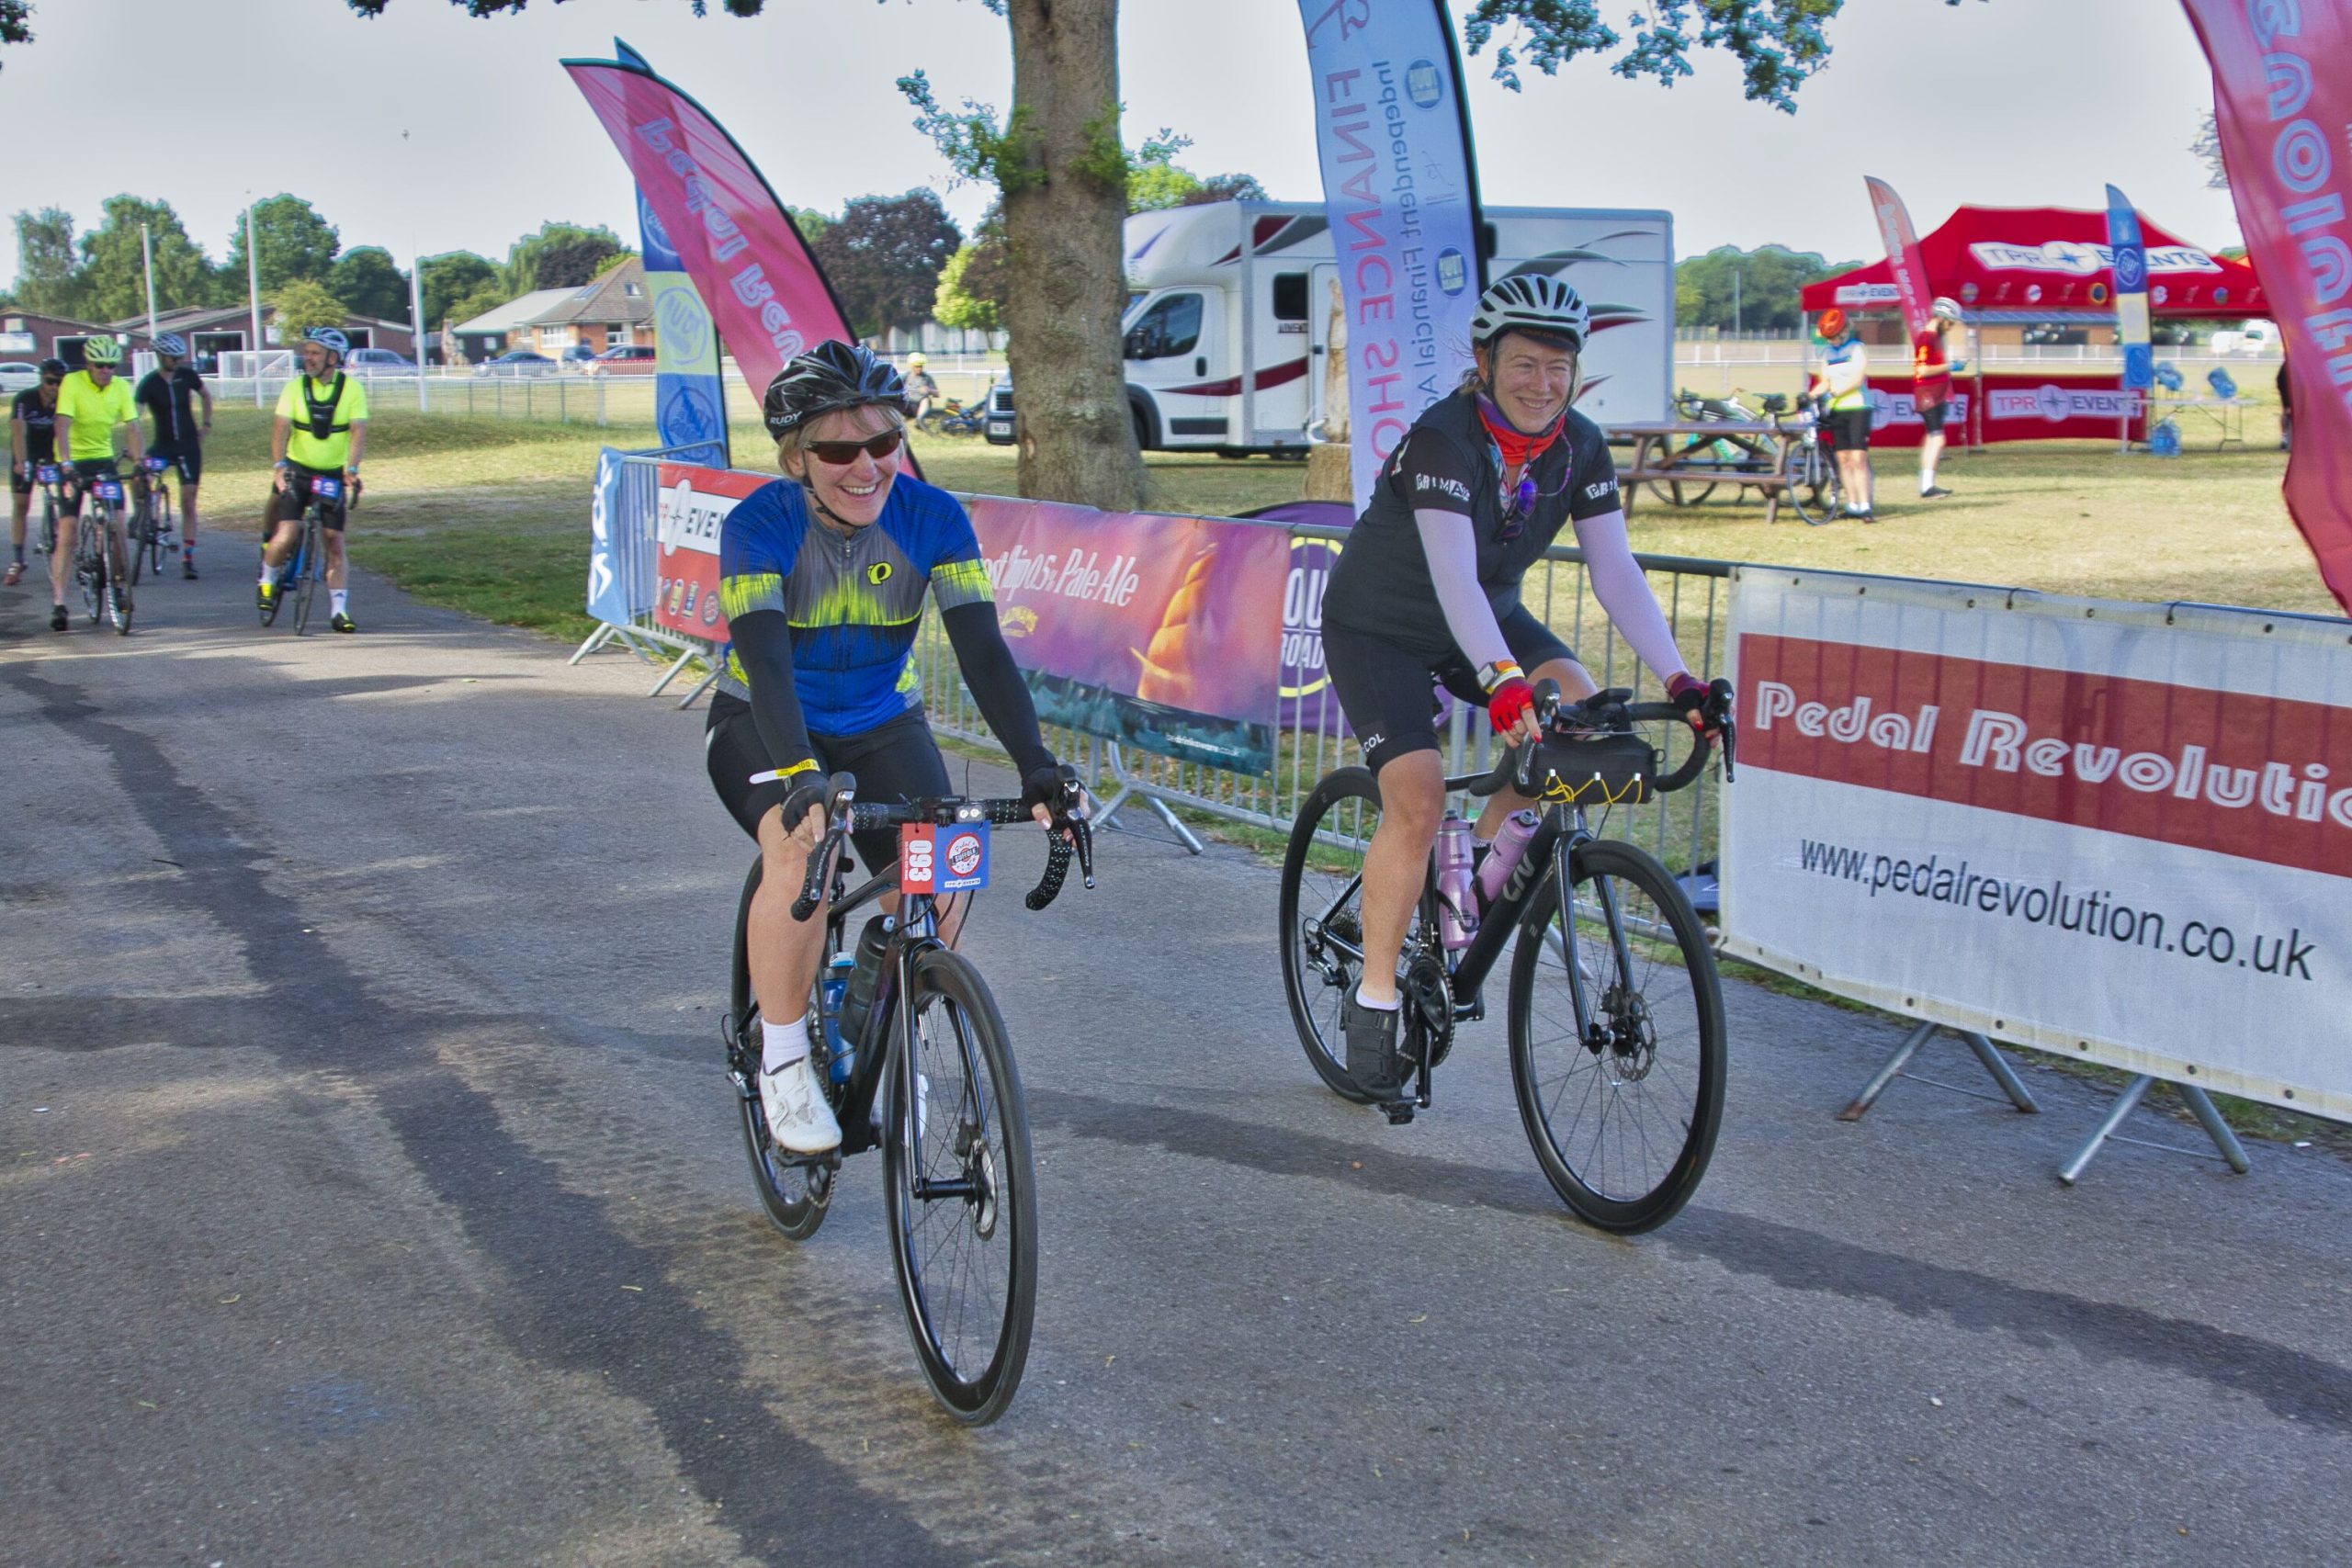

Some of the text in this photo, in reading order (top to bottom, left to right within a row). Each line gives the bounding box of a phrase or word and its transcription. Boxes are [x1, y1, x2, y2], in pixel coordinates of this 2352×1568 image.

[770, 411, 803, 425] RUDY
[1996, 396, 2037, 412] TPR
[1054, 547, 1100, 599] Pale
[1092, 554, 1139, 607] Ale
[1755, 681, 1940, 754] Pedal
[1801, 838, 2318, 981] www.pedalrevolution.co.uk
